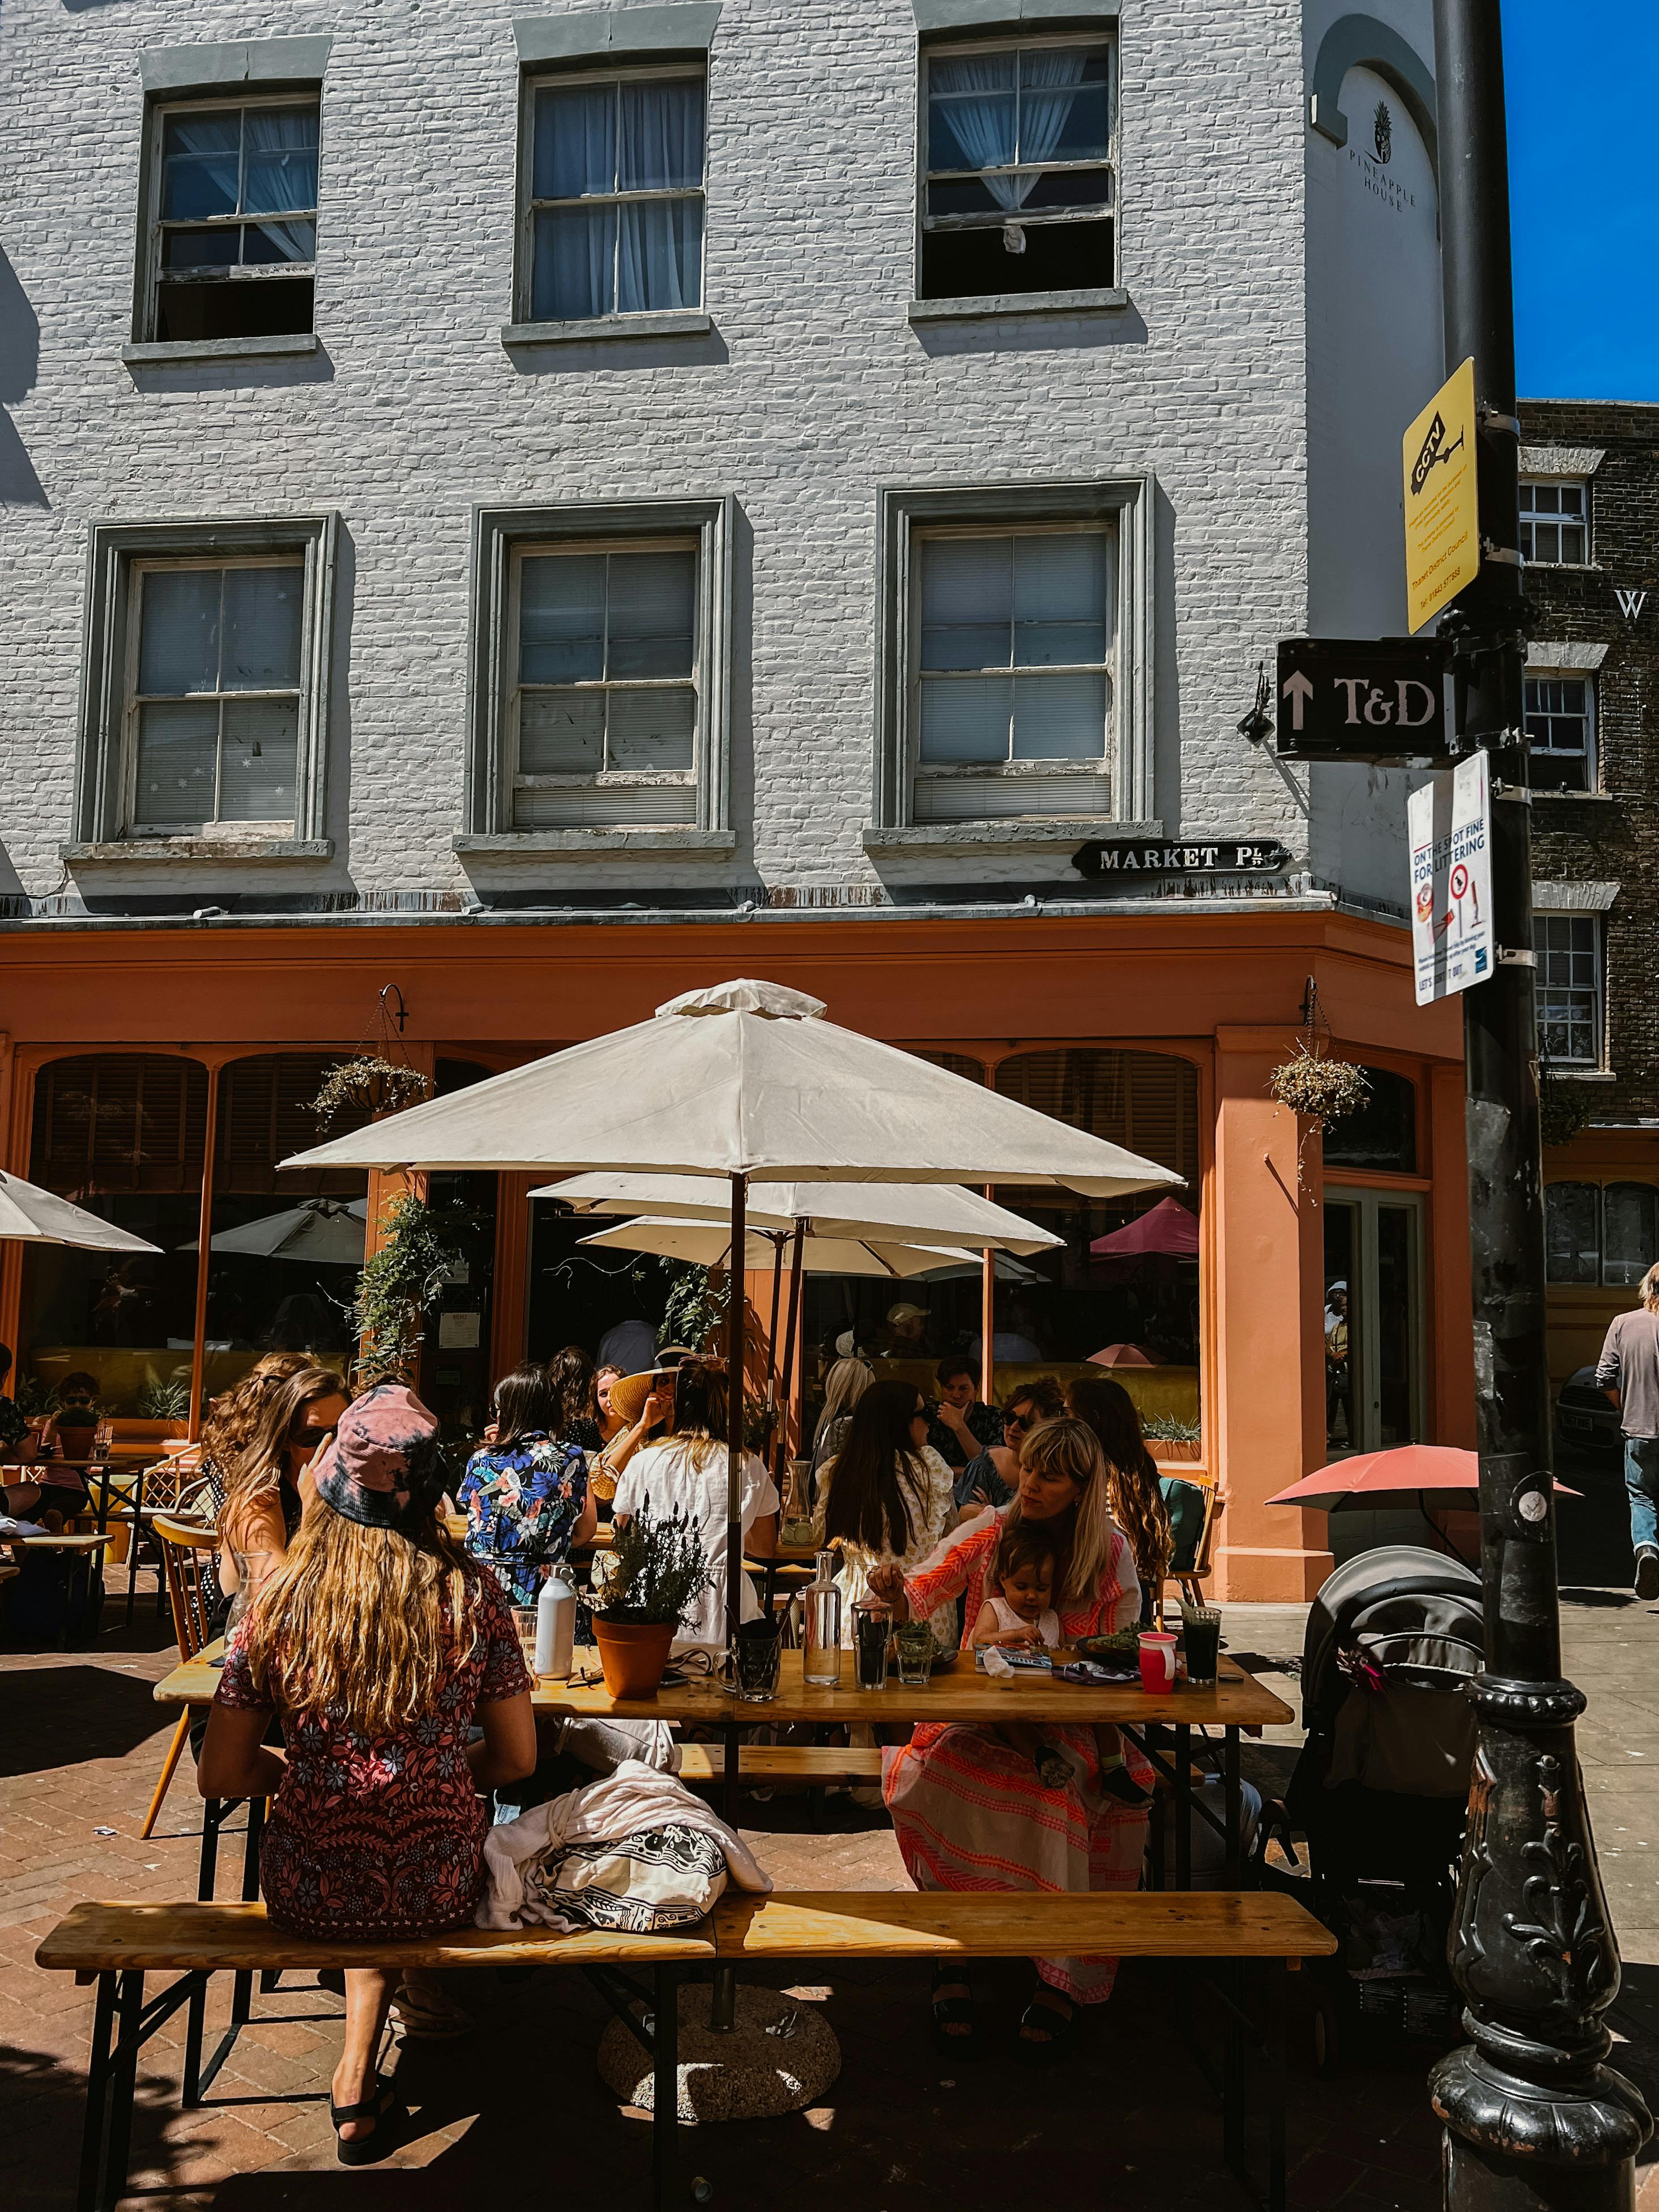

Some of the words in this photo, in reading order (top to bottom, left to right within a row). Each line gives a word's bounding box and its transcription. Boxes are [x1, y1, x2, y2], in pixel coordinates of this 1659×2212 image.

[1349, 150, 1416, 207] PINEAPPLE
[1364, 176, 1402, 213] HOUSE
[1417, 421, 1440, 483] CCTV
[1412, 570, 1428, 591] Thanet
[1429, 552, 1447, 574] District
[1448, 530, 1468, 556] Council
[1613, 589, 1648, 619] W
[1333, 677, 1435, 726] T&D
[1100, 847, 1218, 870] MARKET
[1414, 851, 1426, 866] ON
[1427, 842, 1442, 859] THE
[1444, 830, 1464, 850] SPOT
[1466, 819, 1485, 839] FINE
[1414, 863, 1433, 884] FOR
[1435, 834, 1485, 873] LITTERING
[1452, 964, 1463, 977] OUT
